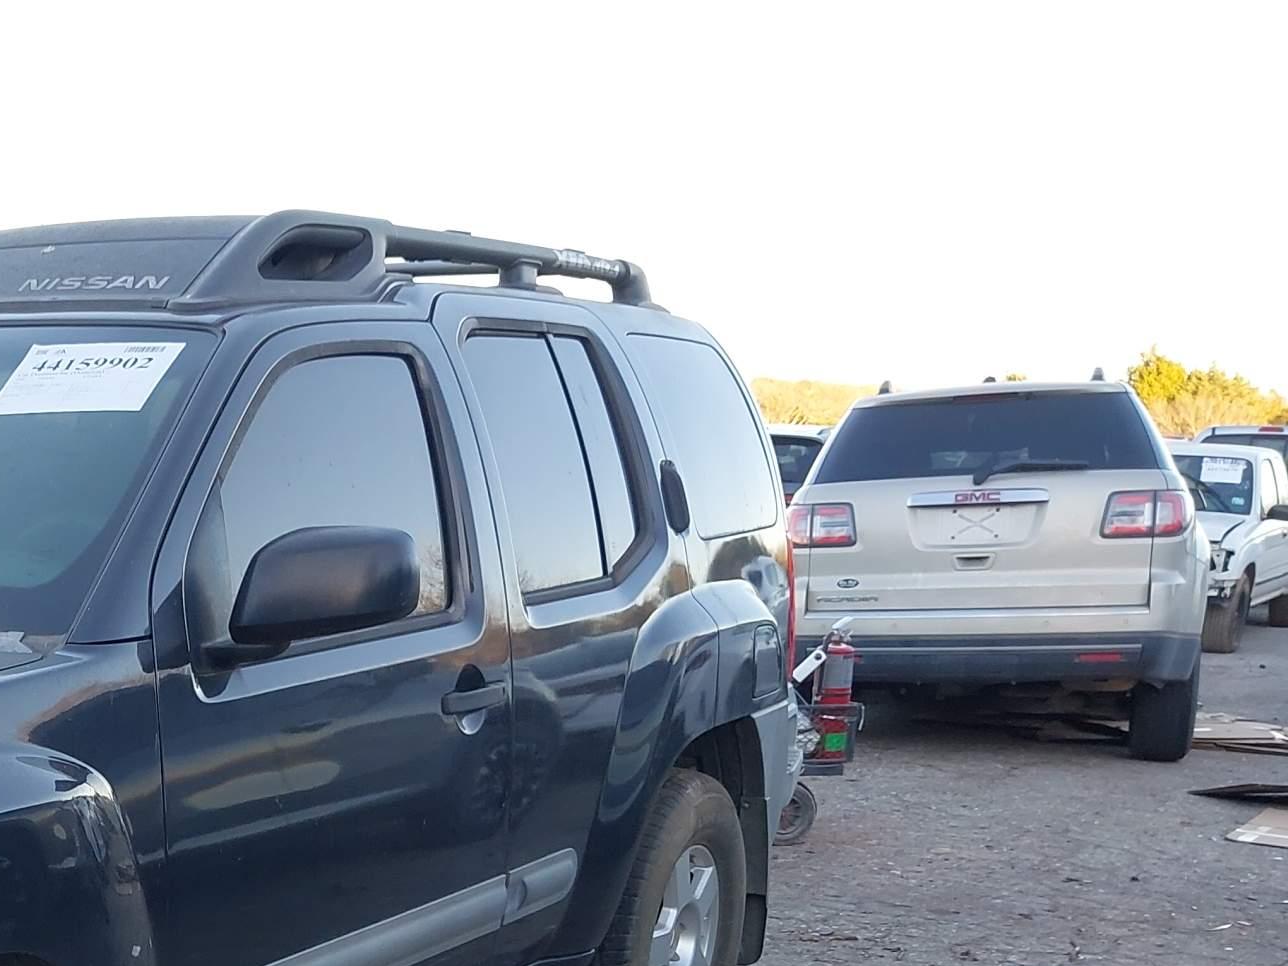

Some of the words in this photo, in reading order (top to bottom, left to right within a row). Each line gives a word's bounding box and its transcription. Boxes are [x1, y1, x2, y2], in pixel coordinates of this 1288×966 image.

[17, 275, 170, 292] NISSAN
[32, 356, 154, 373] 44159902
[954, 491, 1001, 503] GMC
